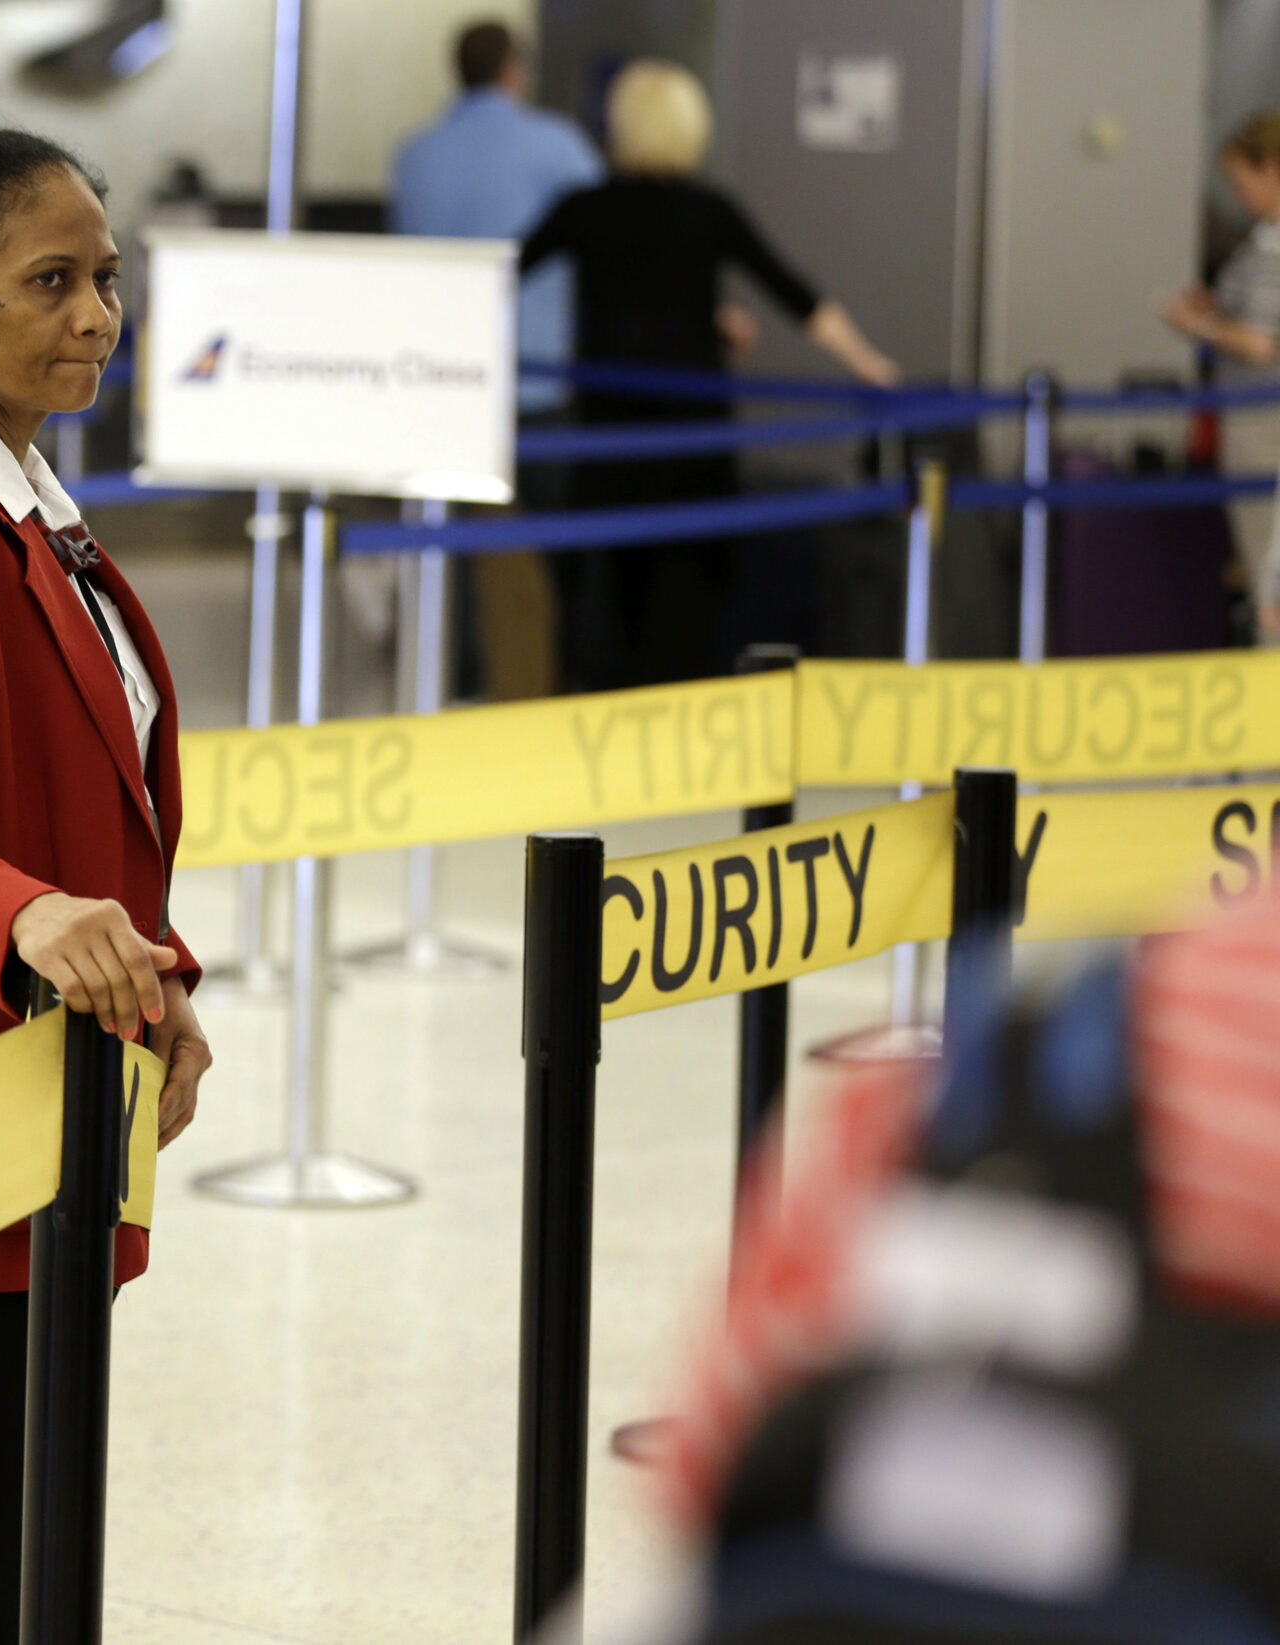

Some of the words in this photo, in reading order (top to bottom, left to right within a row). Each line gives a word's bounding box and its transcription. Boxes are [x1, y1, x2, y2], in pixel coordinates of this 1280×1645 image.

[239, 344, 386, 390] Economy
[1210, 801, 1280, 910] S
[600, 823, 875, 1005] CURITY
